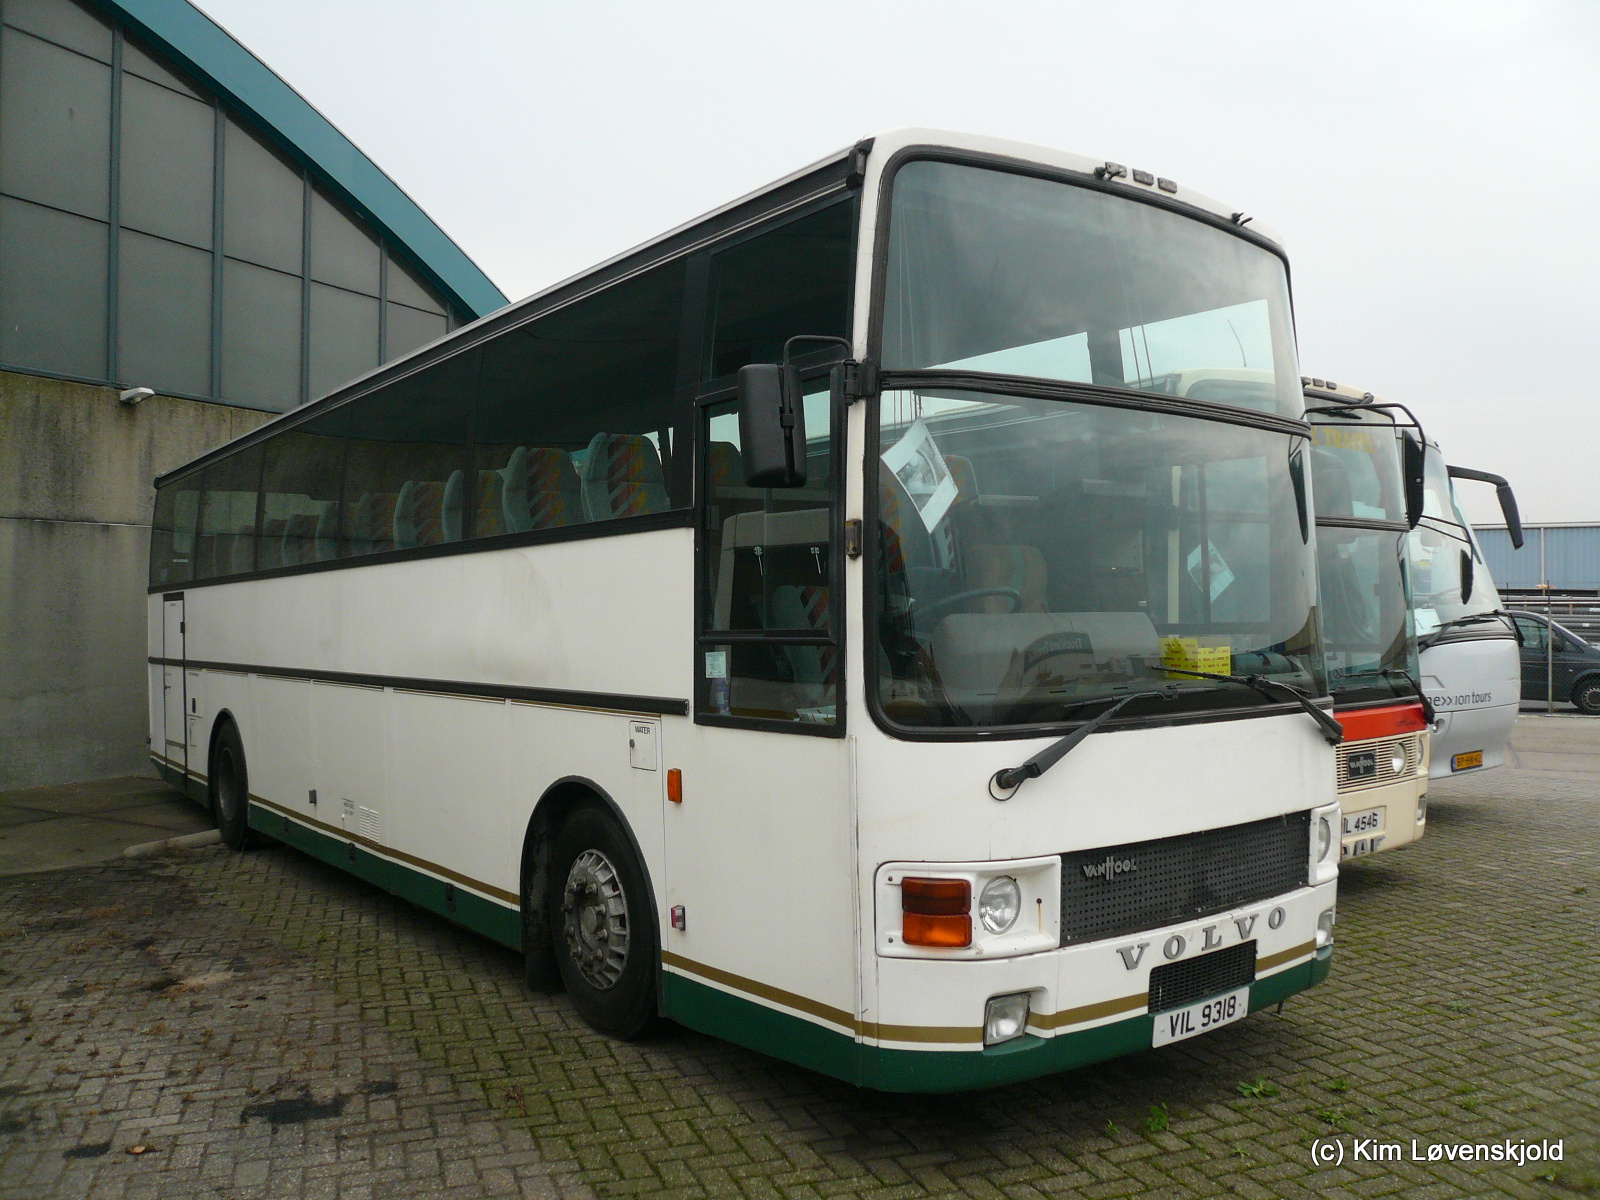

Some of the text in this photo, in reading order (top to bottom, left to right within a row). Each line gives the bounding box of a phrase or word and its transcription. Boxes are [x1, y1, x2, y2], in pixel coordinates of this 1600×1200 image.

[1472, 691, 1492, 704] tours
[635, 725, 651, 735] WATER
[1116, 906, 1286, 971] VOLVO
[1169, 995, 1237, 1037] VIL 9318
